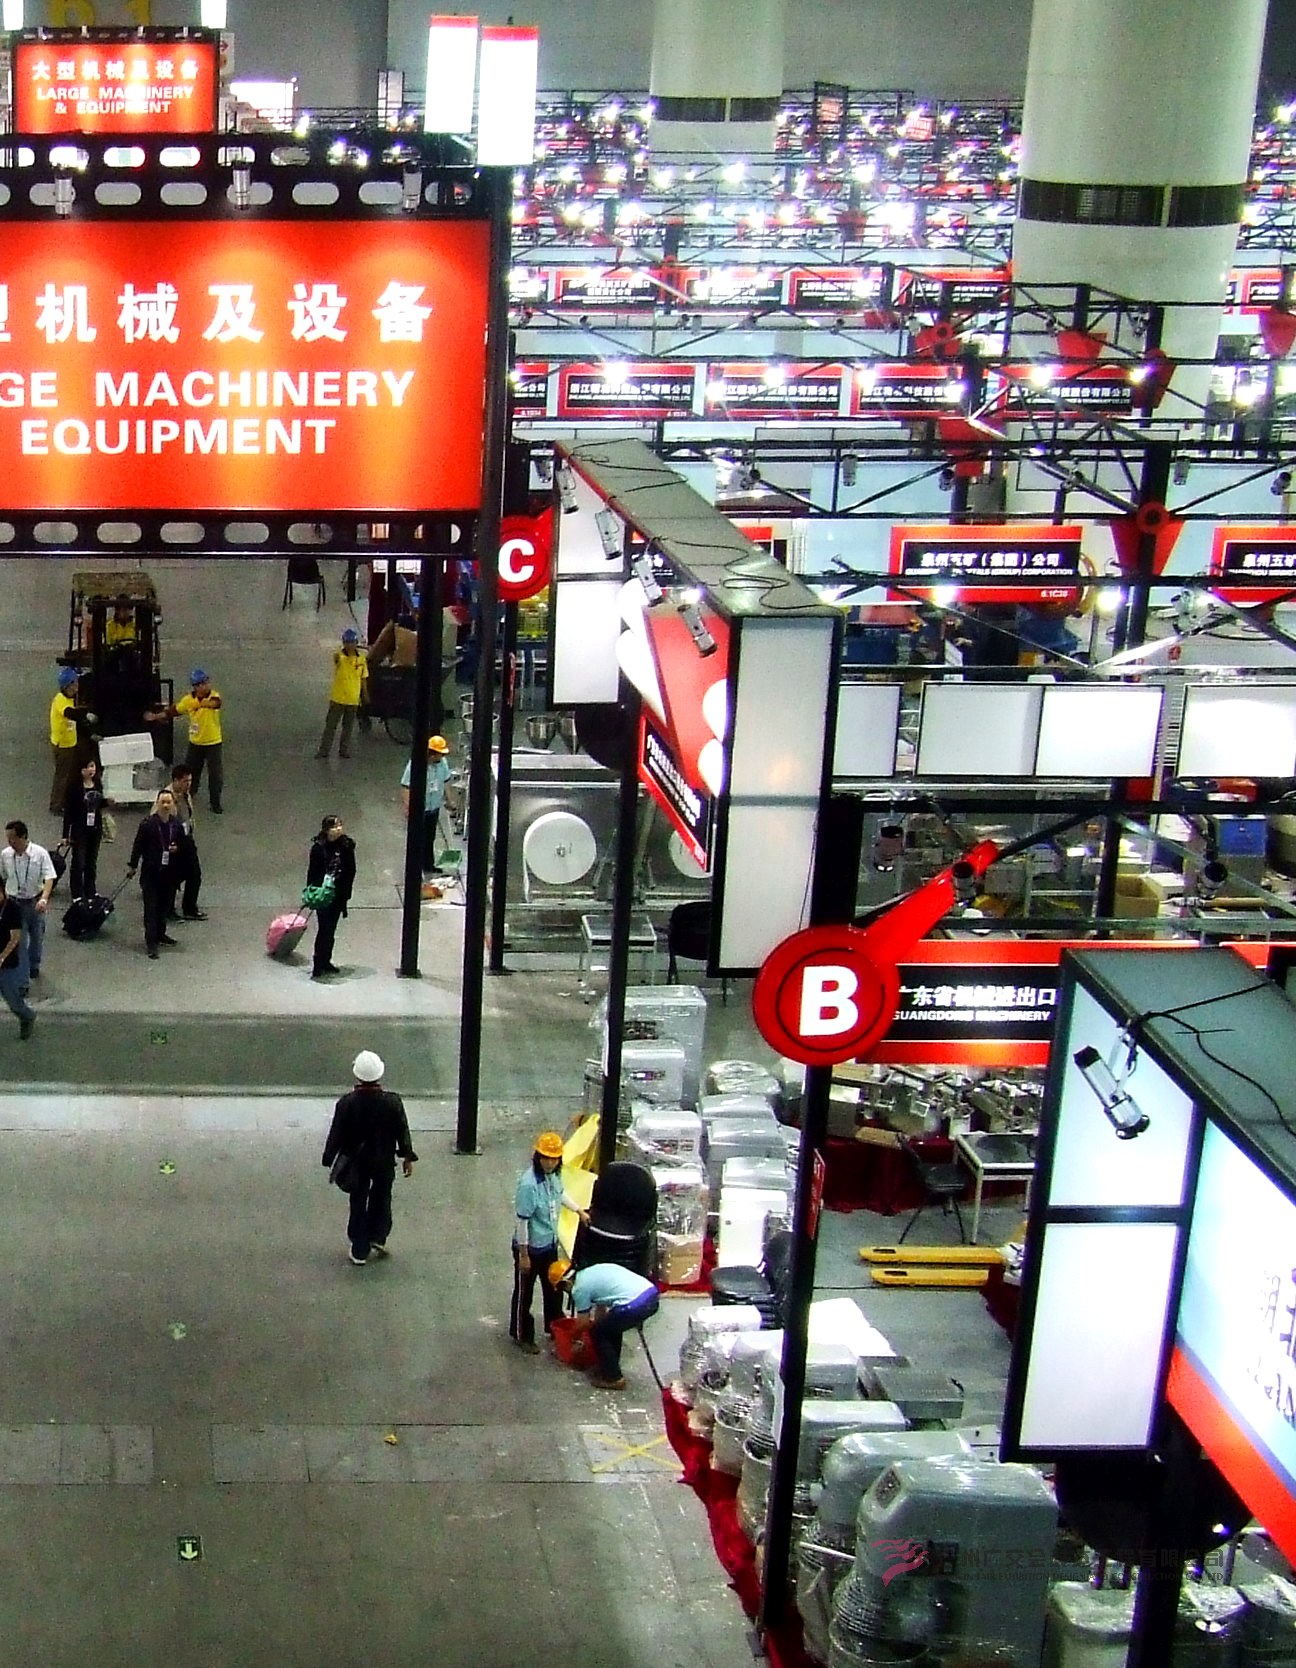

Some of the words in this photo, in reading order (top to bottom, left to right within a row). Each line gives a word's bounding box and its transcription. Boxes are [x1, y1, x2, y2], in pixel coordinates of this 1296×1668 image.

[32, 60, 199, 81] 大型机械及设备
[37, 86, 89, 100] LARGE
[99, 86, 193, 100] MACHINERY
[55, 102, 67, 114] &
[77, 101, 171, 114] EQUIPMENT
[95, 371, 416, 409] MACHINERY
[22, 419, 337, 456] EQUIPMENT
[498, 538, 535, 583] C
[798, 965, 859, 1037] B
